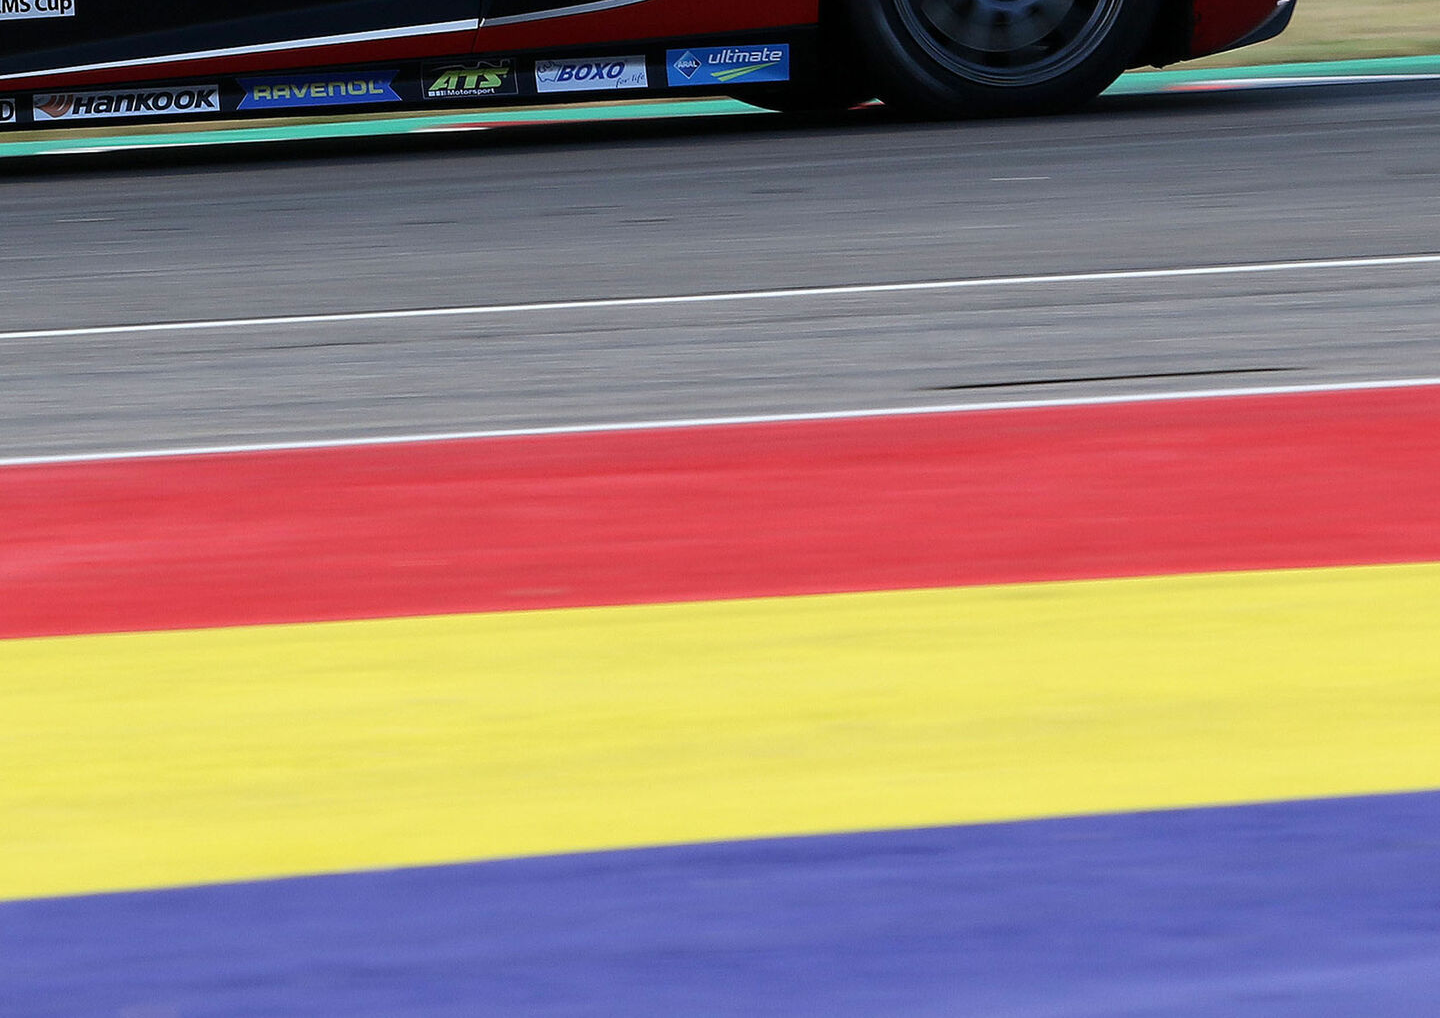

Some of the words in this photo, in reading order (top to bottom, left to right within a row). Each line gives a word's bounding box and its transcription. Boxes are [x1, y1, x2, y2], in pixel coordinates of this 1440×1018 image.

[708, 47, 782, 64] ultimate
[428, 68, 509, 91] ATS
[557, 62, 625, 82] BOXO
[447, 88, 495, 96] Motorsport
